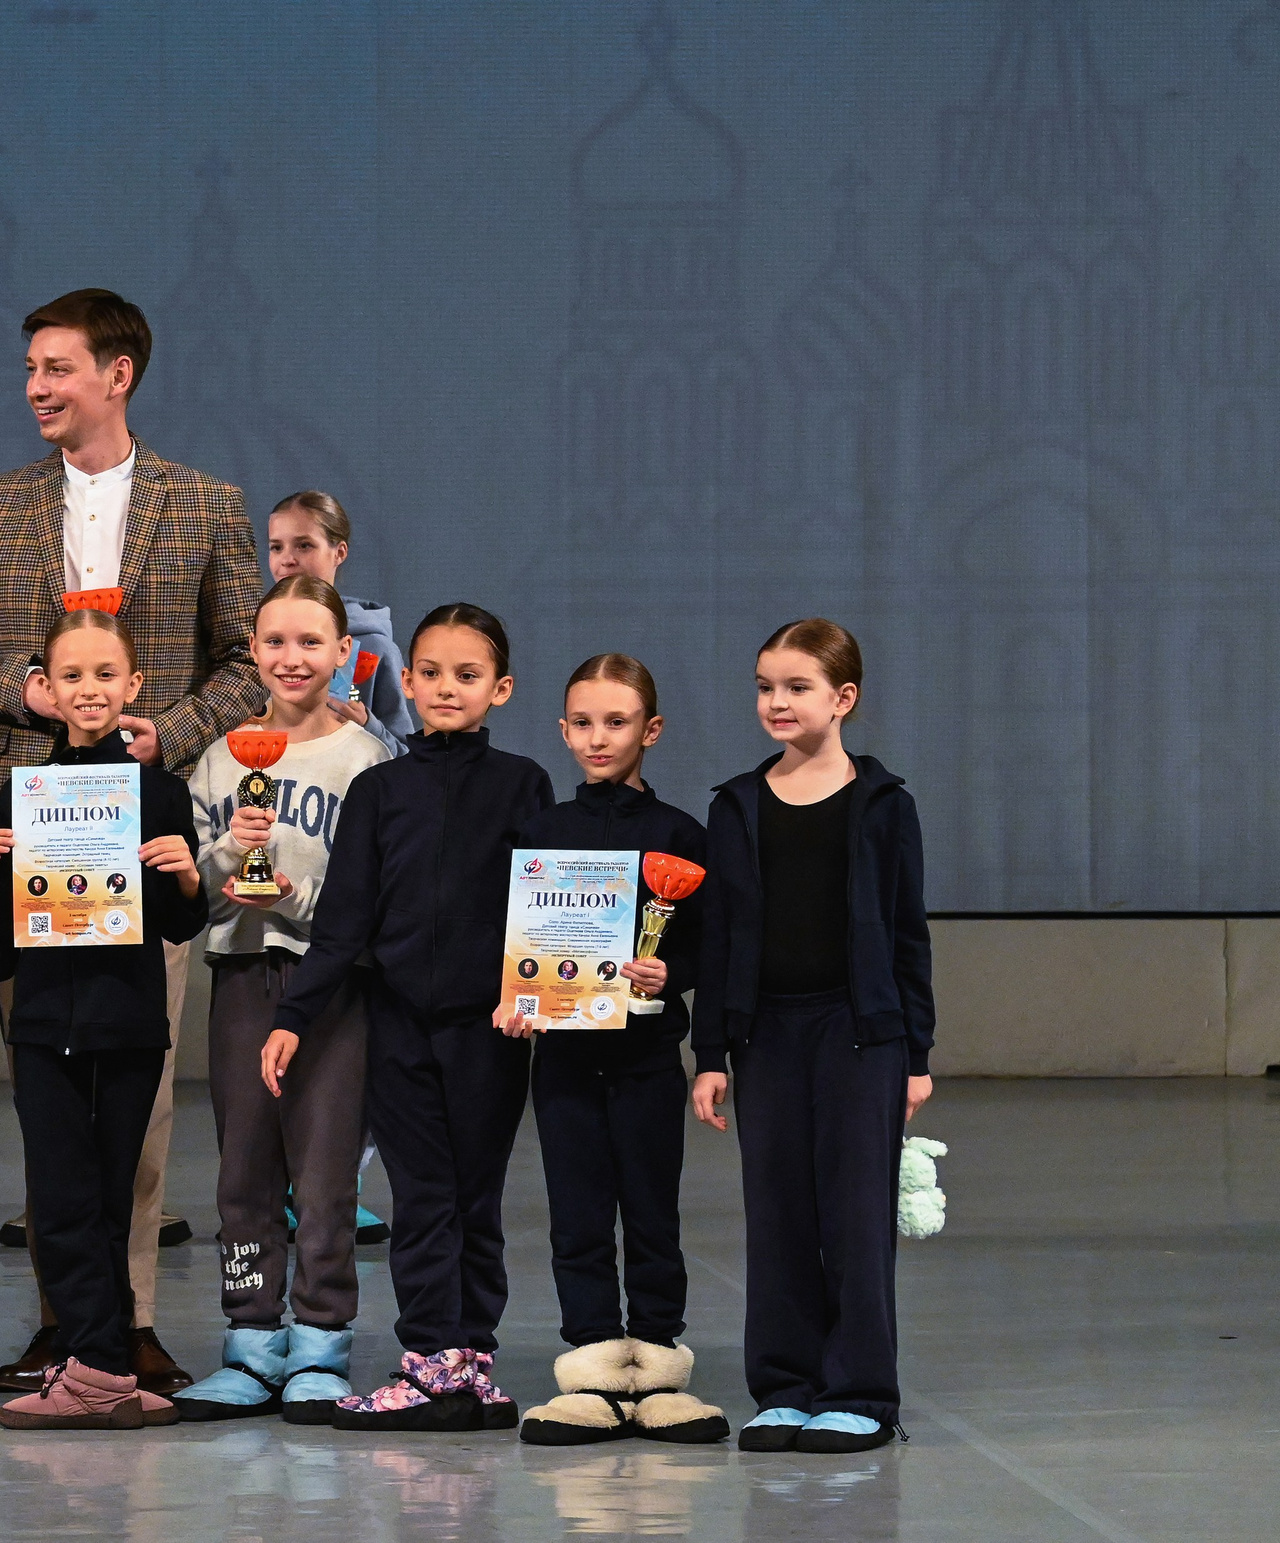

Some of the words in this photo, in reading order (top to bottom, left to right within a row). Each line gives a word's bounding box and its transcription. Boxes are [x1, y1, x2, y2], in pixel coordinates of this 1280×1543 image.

[32, 806, 121, 826] ДИПЛОМ
[527, 892, 618, 910] ДИПЛОМ
[233, 1242, 260, 1259] joy
[225, 1260, 250, 1279] the
